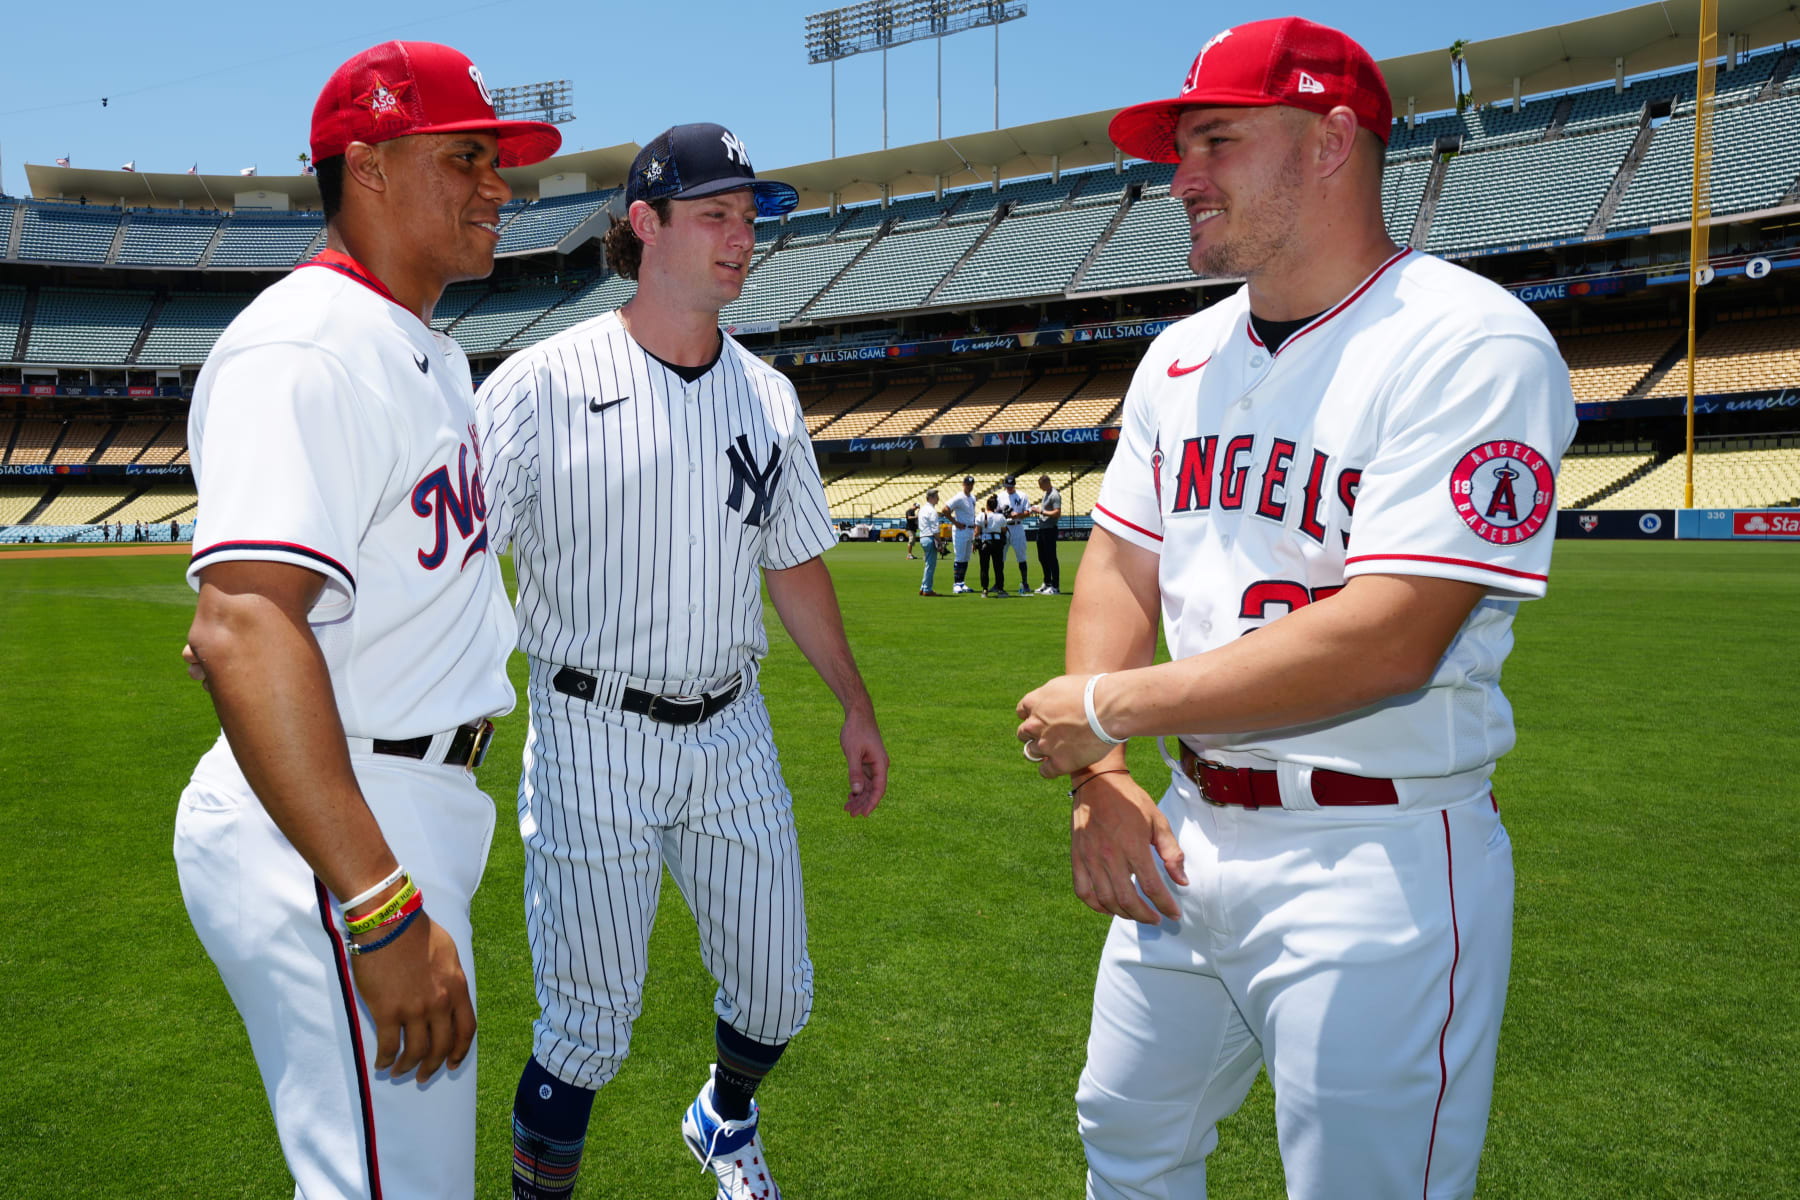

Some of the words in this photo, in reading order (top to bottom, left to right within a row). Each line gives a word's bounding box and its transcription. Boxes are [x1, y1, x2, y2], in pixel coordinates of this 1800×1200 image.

[372, 94, 397, 110] ASG
[647, 167, 662, 179] ASG
[1754, 261, 1763, 274] 2
[1520, 285, 1565, 301] GAME
[1094, 328, 1114, 340] ALL
[1116, 325, 1143, 338] STAR
[1144, 322, 1171, 335] GA
[820, 352, 835, 362] ALL
[837, 350, 859, 361] STAR
[859, 347, 886, 359] GAME
[1726, 389, 1800, 411] angele
[1006, 431, 1027, 445] ALL
[1030, 430, 1060, 444] STAR
[1061, 429, 1100, 443] GAME
[1471, 443, 1544, 471] ANGELS
[23, 465, 54, 475] GAME
[725, 434, 783, 527] NY
[1151, 429, 1363, 549] NGELS
[1485, 460, 1519, 521] A
[1458, 502, 1543, 542] BASEBALL
[1707, 511, 1726, 520] 330
[1771, 516, 1800, 532] Sta
